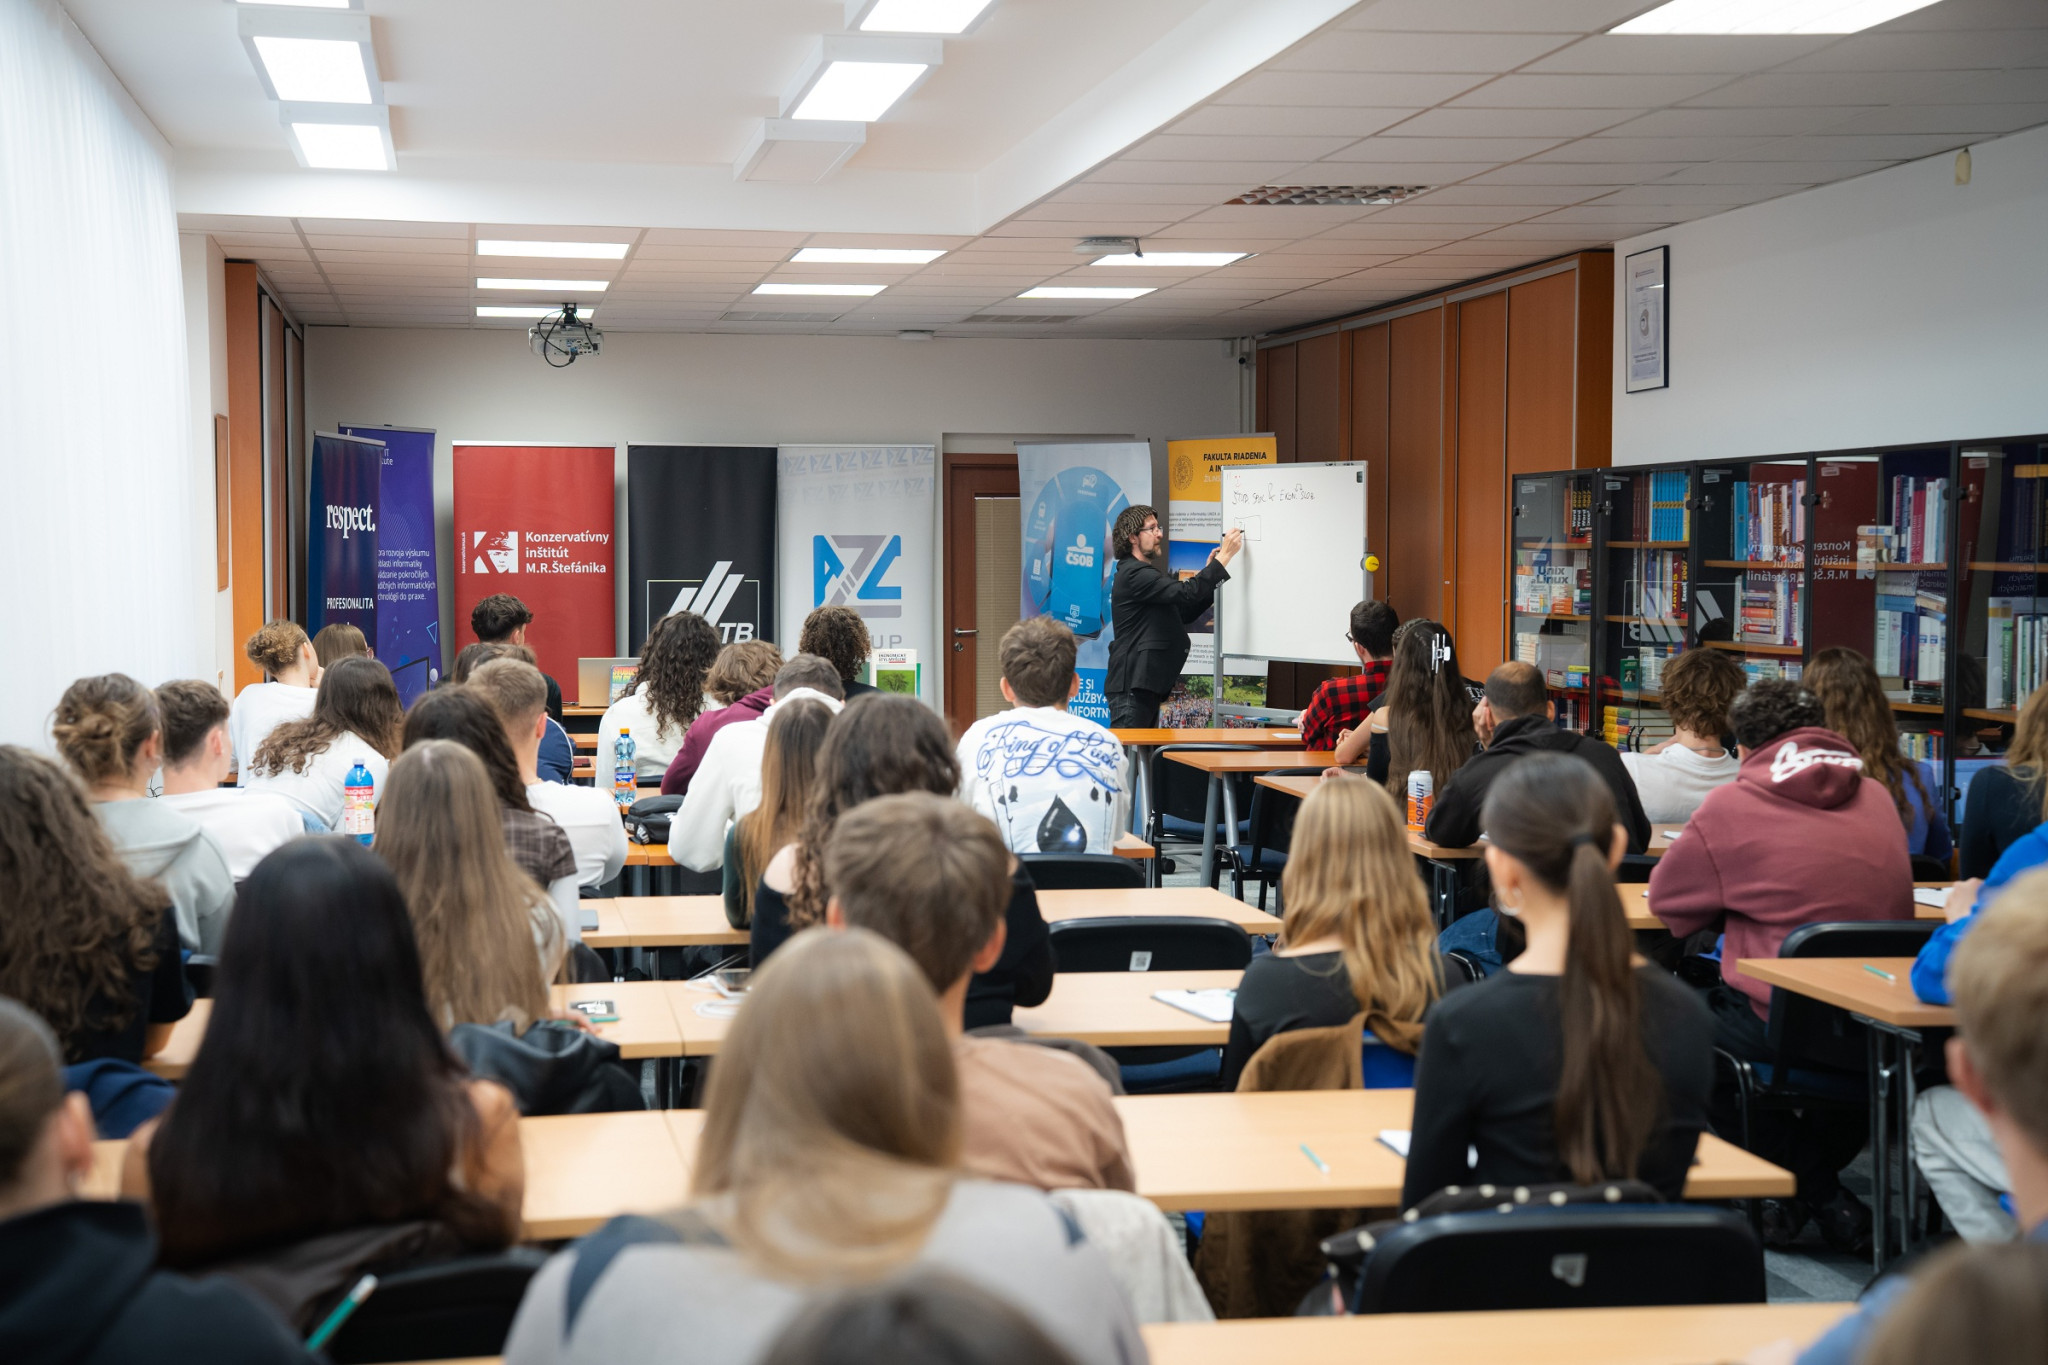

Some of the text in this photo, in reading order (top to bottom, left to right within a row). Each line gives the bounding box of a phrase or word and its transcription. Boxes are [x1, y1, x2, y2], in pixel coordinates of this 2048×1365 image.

[1203, 451, 1267, 461] FAKULTA RIADENIA
[326, 504, 376, 539] respect.
[525, 530, 609, 544] Konzervatívny
[526, 547, 569, 558] inštitút
[1066, 551, 1094, 568] ČSOB
[526, 561, 606, 573] M.R.Štefánika
[1538, 566, 1565, 575] Unix
[1537, 574, 1569, 584] Linux
[326, 597, 374, 610] PROFESIONALITA
[719, 622, 754, 644] TB
[872, 635, 902, 649] UP
[1085, 679, 1094, 690] SI
[1067, 706, 1110, 718] MFORTN
[1416, 781, 1425, 825] ISOFRUIT
